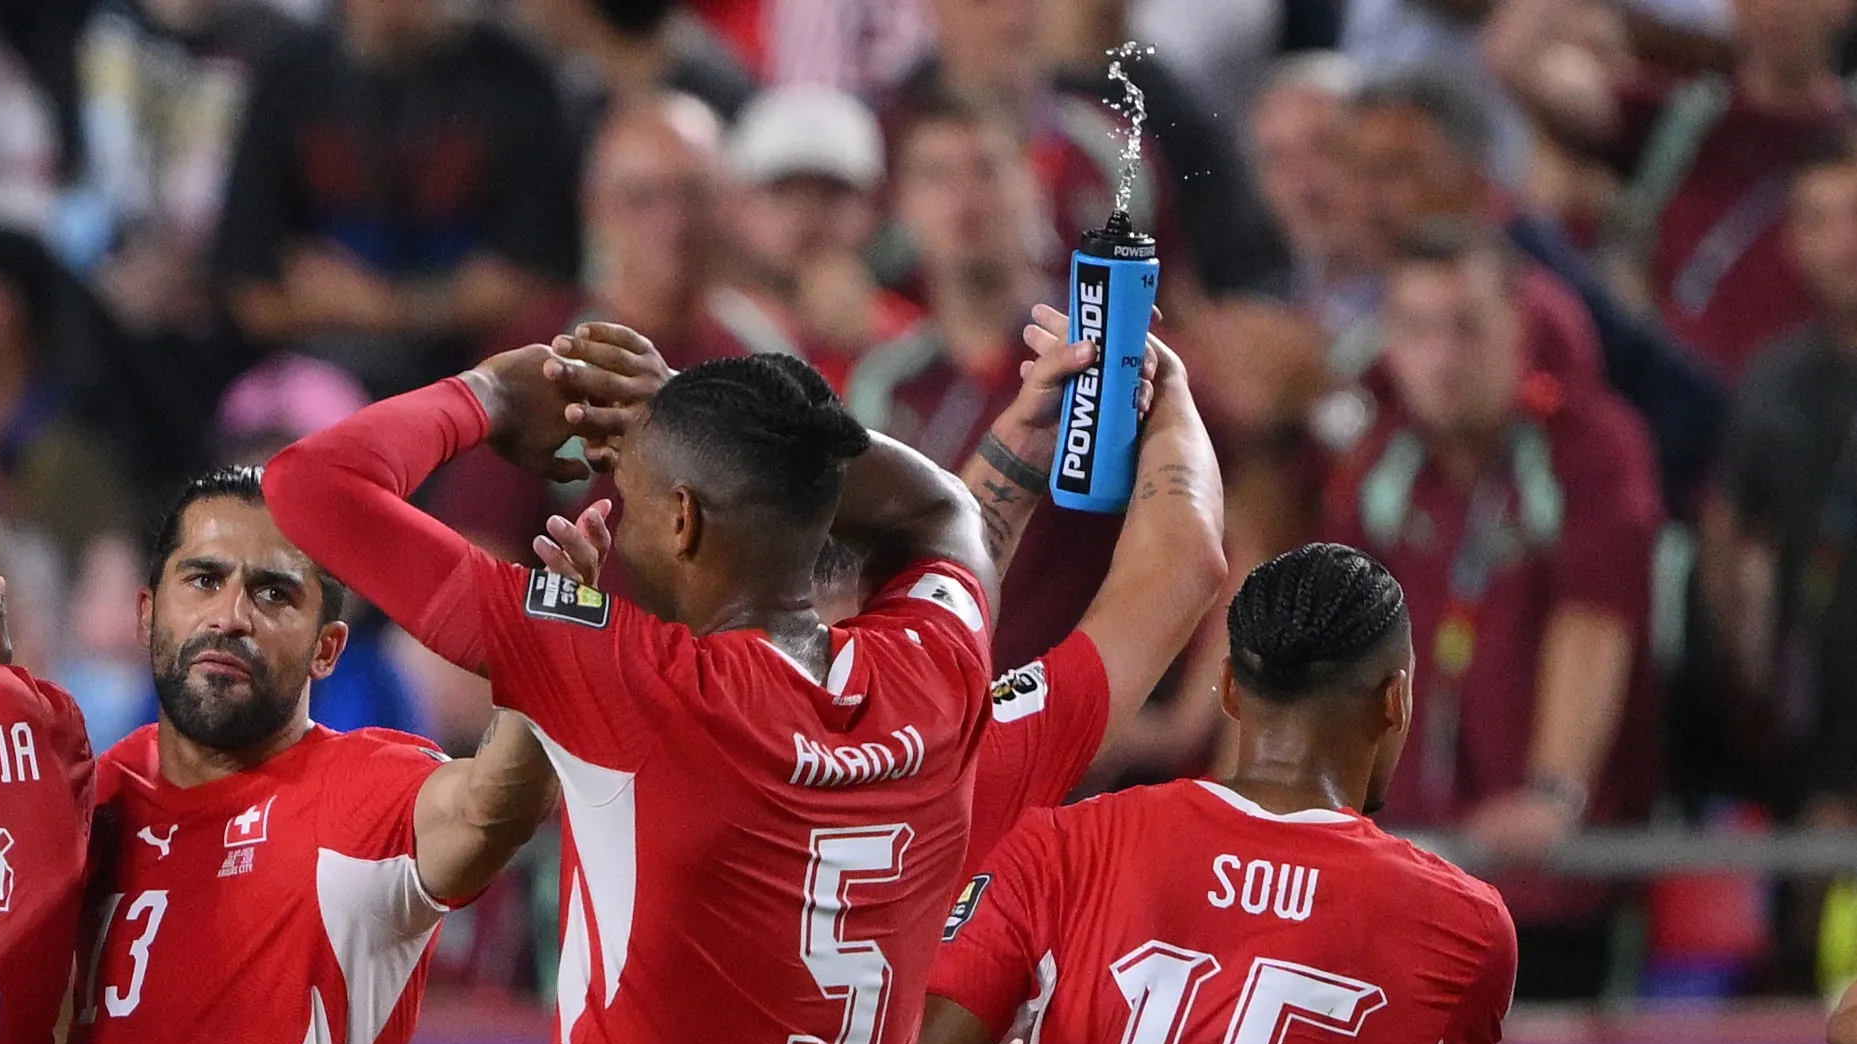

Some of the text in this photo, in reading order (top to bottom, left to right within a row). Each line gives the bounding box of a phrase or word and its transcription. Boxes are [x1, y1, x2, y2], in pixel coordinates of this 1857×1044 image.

[1140, 273, 1154, 288] 14
[1062, 282, 1103, 479] POWEADE
[789, 725, 925, 786] AKANJI
[1207, 854, 1319, 921] SOW
